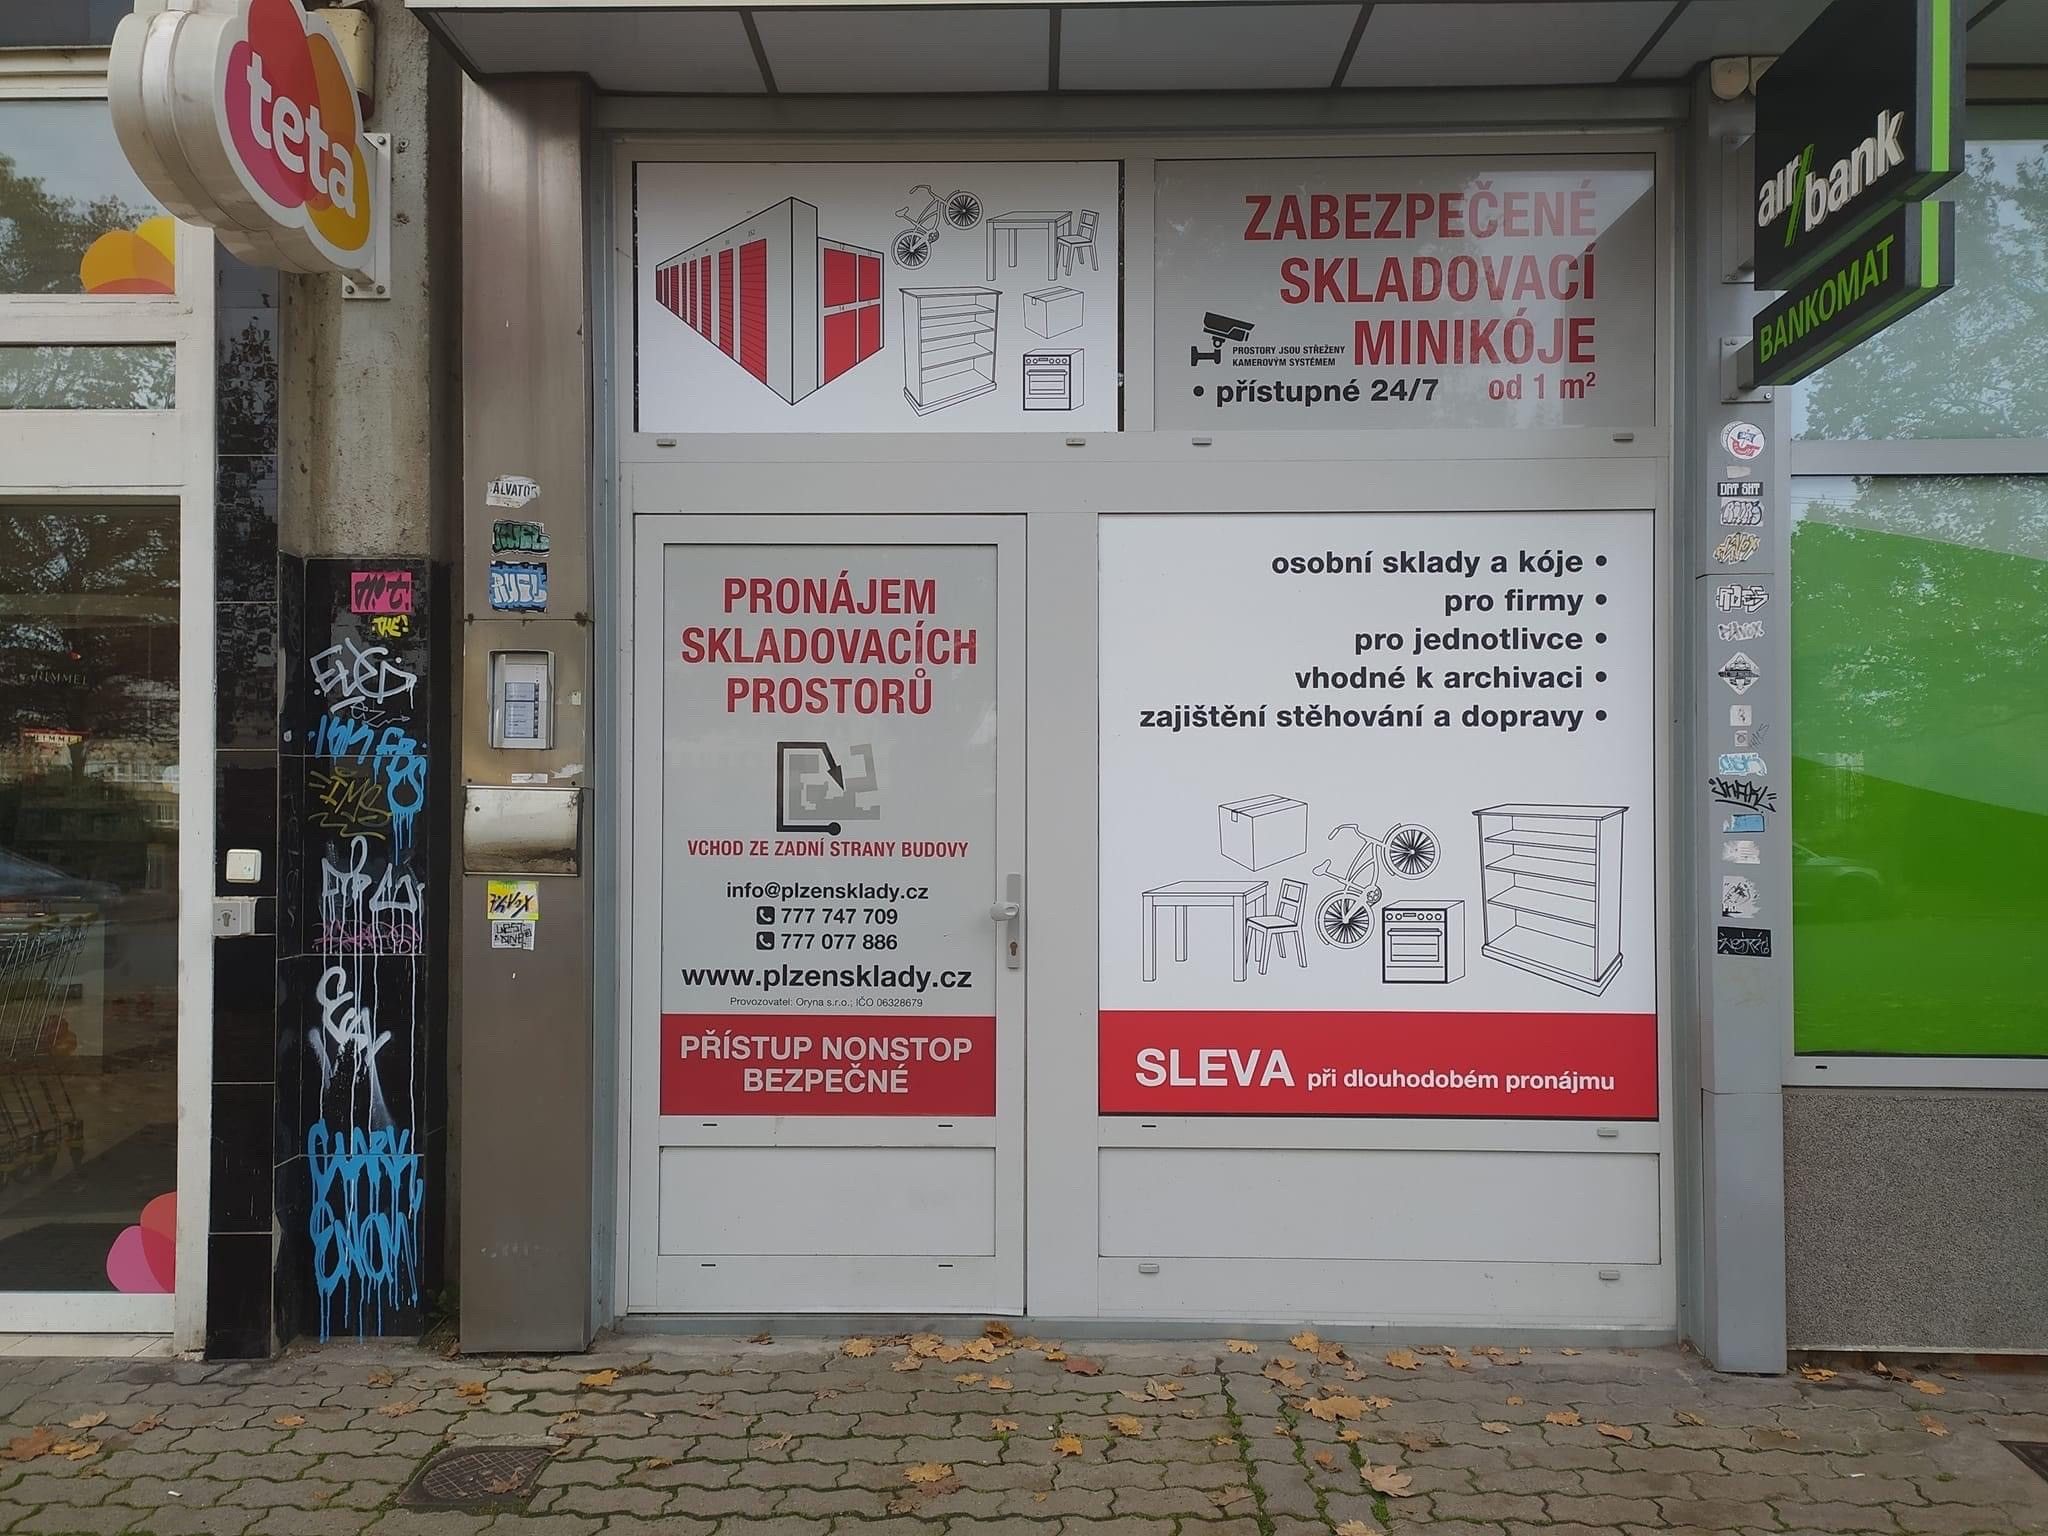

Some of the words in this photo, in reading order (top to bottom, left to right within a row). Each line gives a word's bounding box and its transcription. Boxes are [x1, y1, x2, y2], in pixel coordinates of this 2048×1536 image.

[246, 52, 357, 219] teta
[1804, 108, 1905, 232] bank
[1243, 179, 1597, 241] ZABEZPEČENÉ
[1279, 243, 1595, 304] SKLADOVACÍ
[1759, 233, 1895, 365] BANKOMAT
[1232, 346, 1277, 355] PROSTORY
[1278, 346, 1301, 355] JSOU
[1302, 343, 1346, 355] STŘEŽENY
[1353, 307, 1596, 366] MINIKÓJE
[1232, 356, 1287, 367] KAMEROVÝM
[1288, 356, 1336, 367] SYSTÉMEM
[1216, 378, 1361, 408] přístupné
[1370, 377, 1439, 402] 24/7
[1487, 372, 1523, 401] od
[1534, 374, 1545, 400] 1
[1271, 550, 1374, 574] osobní
[1382, 550, 1481, 579] sklady
[1490, 555, 1508, 573] a
[1519, 549, 1584, 578] kóje
[724, 569, 936, 615] PRONÁJEM
[1445, 594, 1494, 617] pro
[1504, 588, 1584, 617] firmy
[681, 620, 977, 665] SKLADOVACÍCH
[1355, 632, 1404, 656] pro
[1412, 627, 1583, 656] jednotlivce
[727, 667, 932, 715] PROSTORŮ
[1294, 665, 1406, 689] vhodné
[1416, 665, 1434, 689] k
[1443, 665, 1583, 689] archivaci
[1139, 704, 1268, 733] zajištění
[1276, 703, 1425, 728] stěhování
[1433, 709, 1451, 728] a
[1461, 704, 1584, 733] dopravy
[687, 839, 744, 856] VCHOD
[749, 840, 769, 856] ZE
[774, 837, 825, 857] ZADNÍ
[829, 840, 896, 857] STRANY
[901, 841, 969, 858] BUDOVY
[727, 881, 929, 903] info@plzensklady.cz
[780, 907, 816, 924] 777
[821, 908, 857, 924] 747
[863, 908, 898, 925] 709
[780, 933, 816, 950] 777
[821, 933, 857, 950] 077
[862, 934, 898, 950] 886
[681, 963, 972, 993] www.plzensklady.cz
[730, 996, 793, 1007] Provozovatel:
[795, 997, 824, 1009] Oryna
[876, 997, 923, 1008] 06328679
[681, 1029, 813, 1060] PŘÍSTUP
[822, 1036, 973, 1062] NONSTOP
[743, 1062, 909, 1093] BEZPEČNÉ
[1135, 1047, 1296, 1087] SLEVA
[1307, 1068, 1337, 1091] při
[1343, 1068, 1499, 1089] dlouhodobém
[1506, 1070, 1615, 1094] pronájmu
